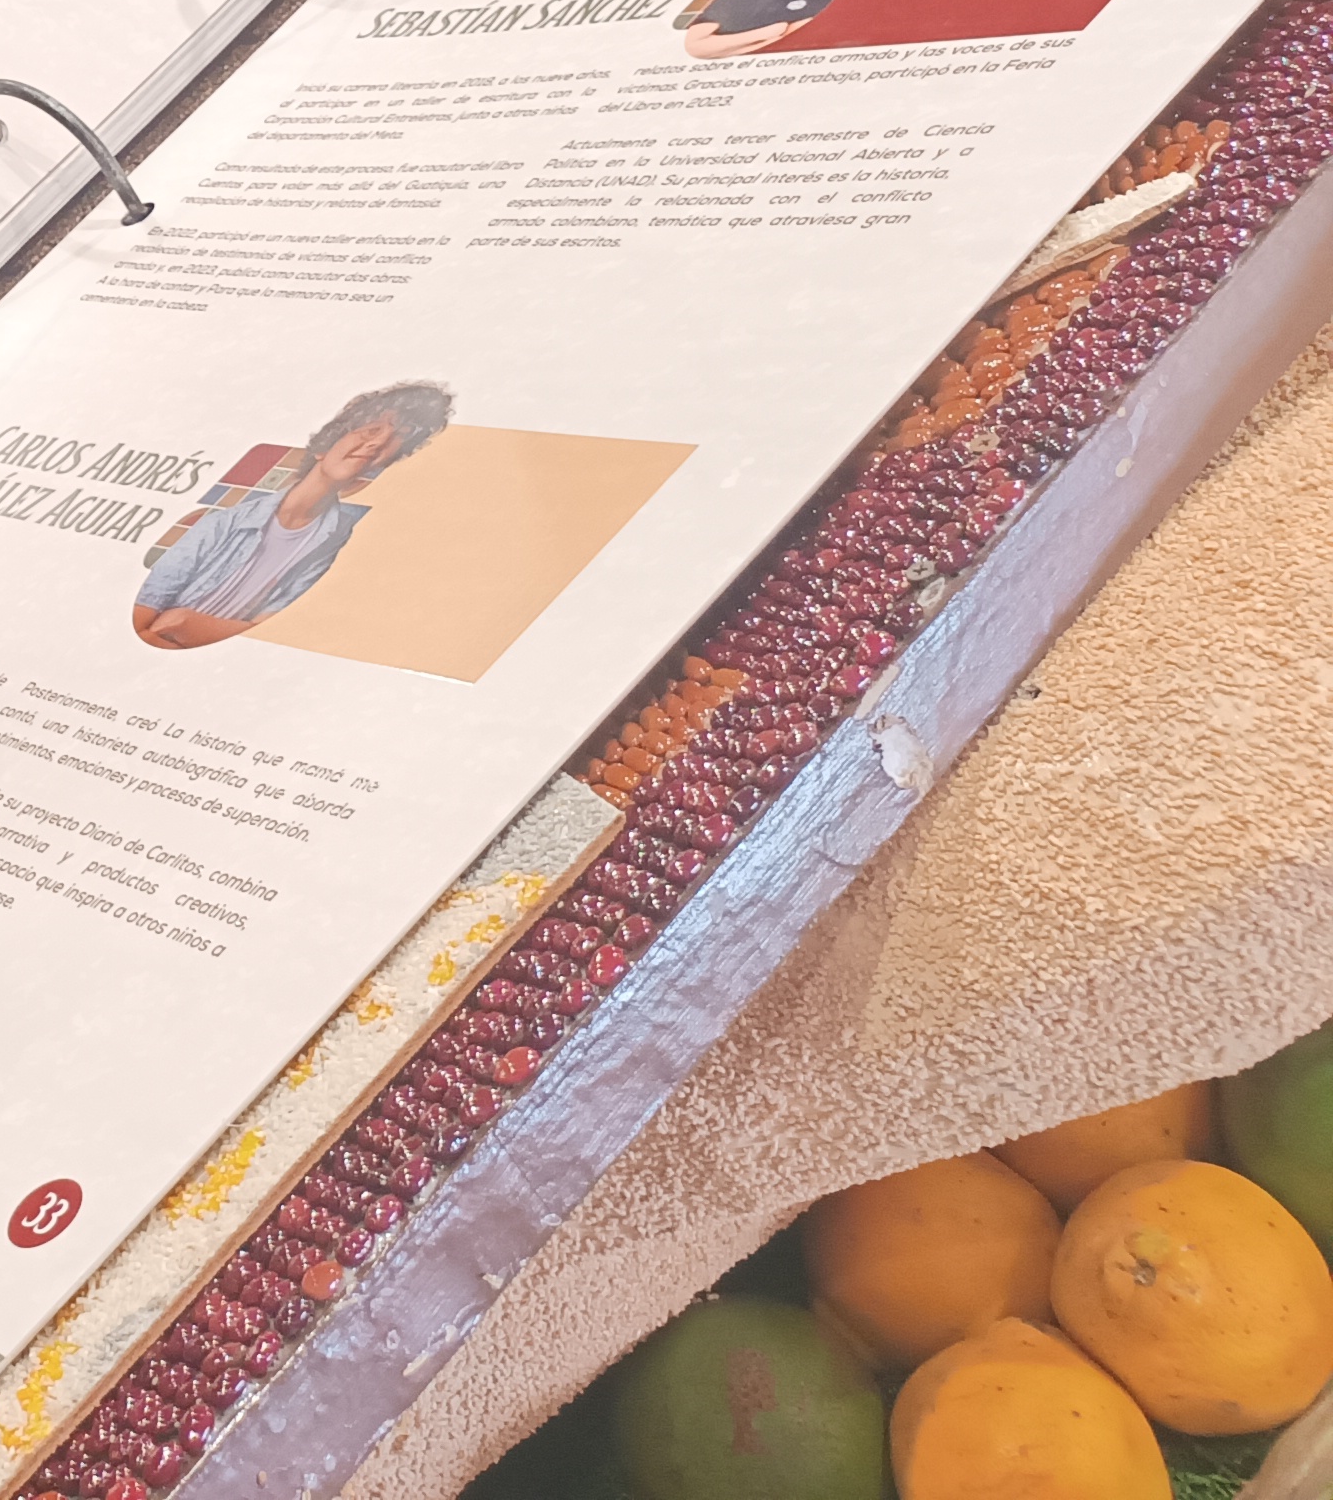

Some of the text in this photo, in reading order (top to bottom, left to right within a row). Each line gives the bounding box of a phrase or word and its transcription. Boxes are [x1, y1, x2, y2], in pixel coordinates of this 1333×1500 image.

[633, 37, 1075, 75] relatos sobre el conflicto armado y las voces de sus
[683, 78, 743, 90] Gracias
[744, 78, 757, 86] a
[758, 75, 795, 85] este
[797, 71, 860, 84] trabajo,
[863, 63, 951, 82] participó
[952, 64, 977, 74] en
[979, 61, 1000, 72] la
[1002, 57, 1056, 70] Feria
[597, 95, 733, 112] del Libro en 2023.
[560, 122, 995, 149] Actualmente cursa tercer semestre de Ciencia
[524, 177, 593, 188] Distancia
[660, 174, 684, 185] Su
[682, 172, 762, 188] principal
[761, 171, 824, 183] interés
[826, 172, 849, 182] es
[851, 169, 872, 181] la
[874, 166, 949, 180] historia,
[543, 147, 974, 168] Política en la Universidad Nacional Abierta y a
[506, 189, 932, 209] especialmente la relacionada con el conflicto
[487, 213, 911, 228] armado colombiano, temática que atraviesa gran
[465, 236, 621, 248] parte de sus escritos.
[77, 442, 215, 495] ANDRÉS
[34, 488, 164, 543] AGUIAR
[42, 719, 69, 734] una
[72, 725, 138, 755] historieta
[142, 750, 248, 788] autobiográfica
[253, 783, 285, 799] que
[125, 715, 161, 731] creó
[162, 722, 184, 738] La
[188, 730, 246, 756] historia
[252, 750, 284, 766] que
[57, 754, 128, 783] emociones
[122, 776, 138, 789] y
[131, 779, 202, 807] procesos
[200, 797, 222, 813] de
[221, 806, 309, 842] superación.
[2, 797, 22, 810] su
[16, 803, 79, 830] proyecto
[79, 821, 122, 846] Diario
[123, 838, 144, 854] de
[145, 845, 204, 878] Carlitos,
[208, 870, 278, 901] combina
[56, 851, 73, 865] y
[80, 860, 159, 894] productos
[174, 894, 247, 930] creativos,
[35, 875, 64, 893] que
[62, 882, 114, 913] inspira
[112, 906, 127, 918] a
[126, 911, 168, 934] otros
[165, 926, 211, 951] niños
[210, 944, 226, 957] a
[21, 1192, 69, 1234] 33
